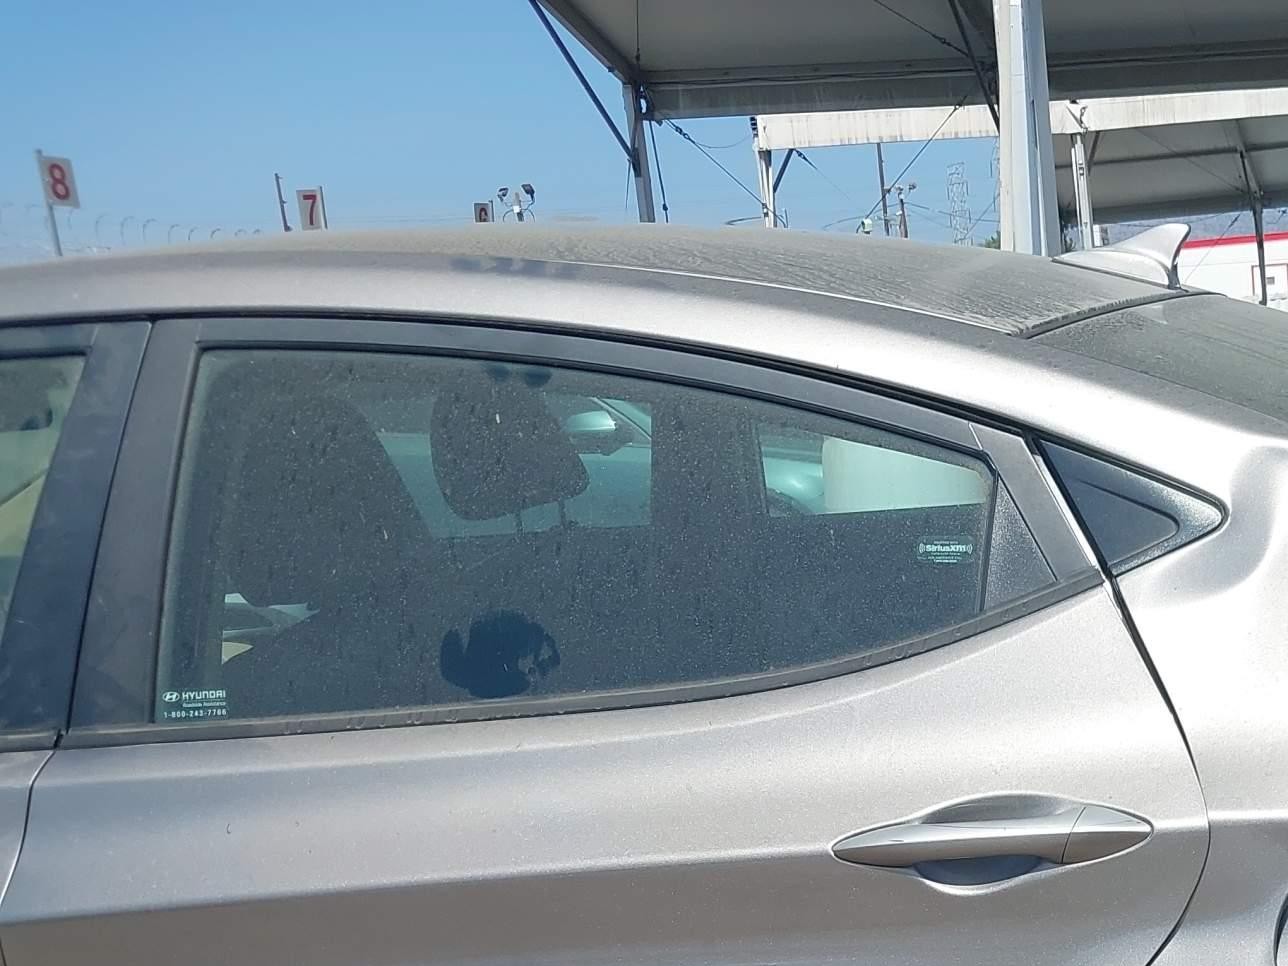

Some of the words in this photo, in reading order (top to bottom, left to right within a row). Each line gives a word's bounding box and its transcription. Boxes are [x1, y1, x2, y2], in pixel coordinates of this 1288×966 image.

[48, 163, 70, 201] 8
[302, 194, 317, 226] 7
[182, 690, 226, 700] HYUNDAI
[163, 709, 227, 718] 1-800-243-7766
